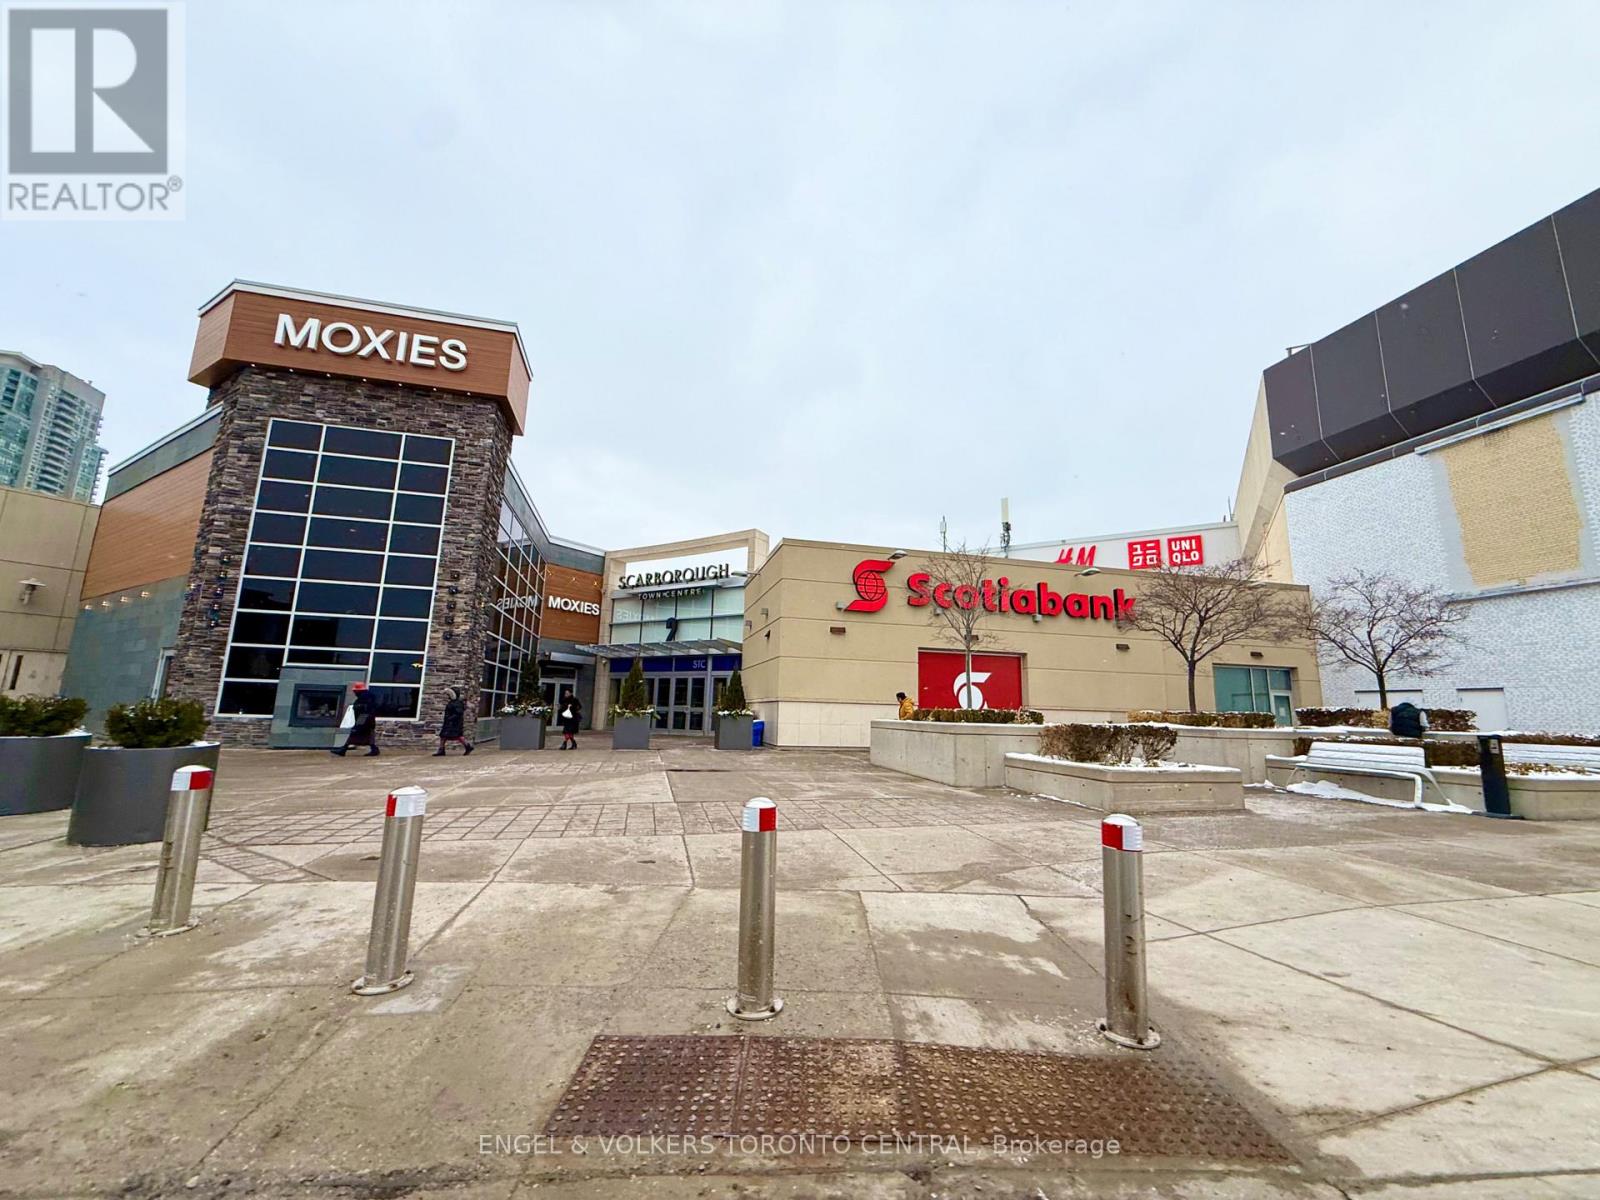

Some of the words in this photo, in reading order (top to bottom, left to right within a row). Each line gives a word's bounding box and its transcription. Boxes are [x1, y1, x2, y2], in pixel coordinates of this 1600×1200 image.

[273, 313, 468, 372] MOXIES
[1171, 539, 1197, 551] UNI
[1172, 551, 1199, 564] QLO
[617, 563, 730, 589] SCARBOROUGH
[638, 591, 661, 600] TOWN
[664, 588, 702, 598] CENTRE
[907, 572, 1136, 621] Scotiabank
[548, 595, 600, 616] MOXIES
